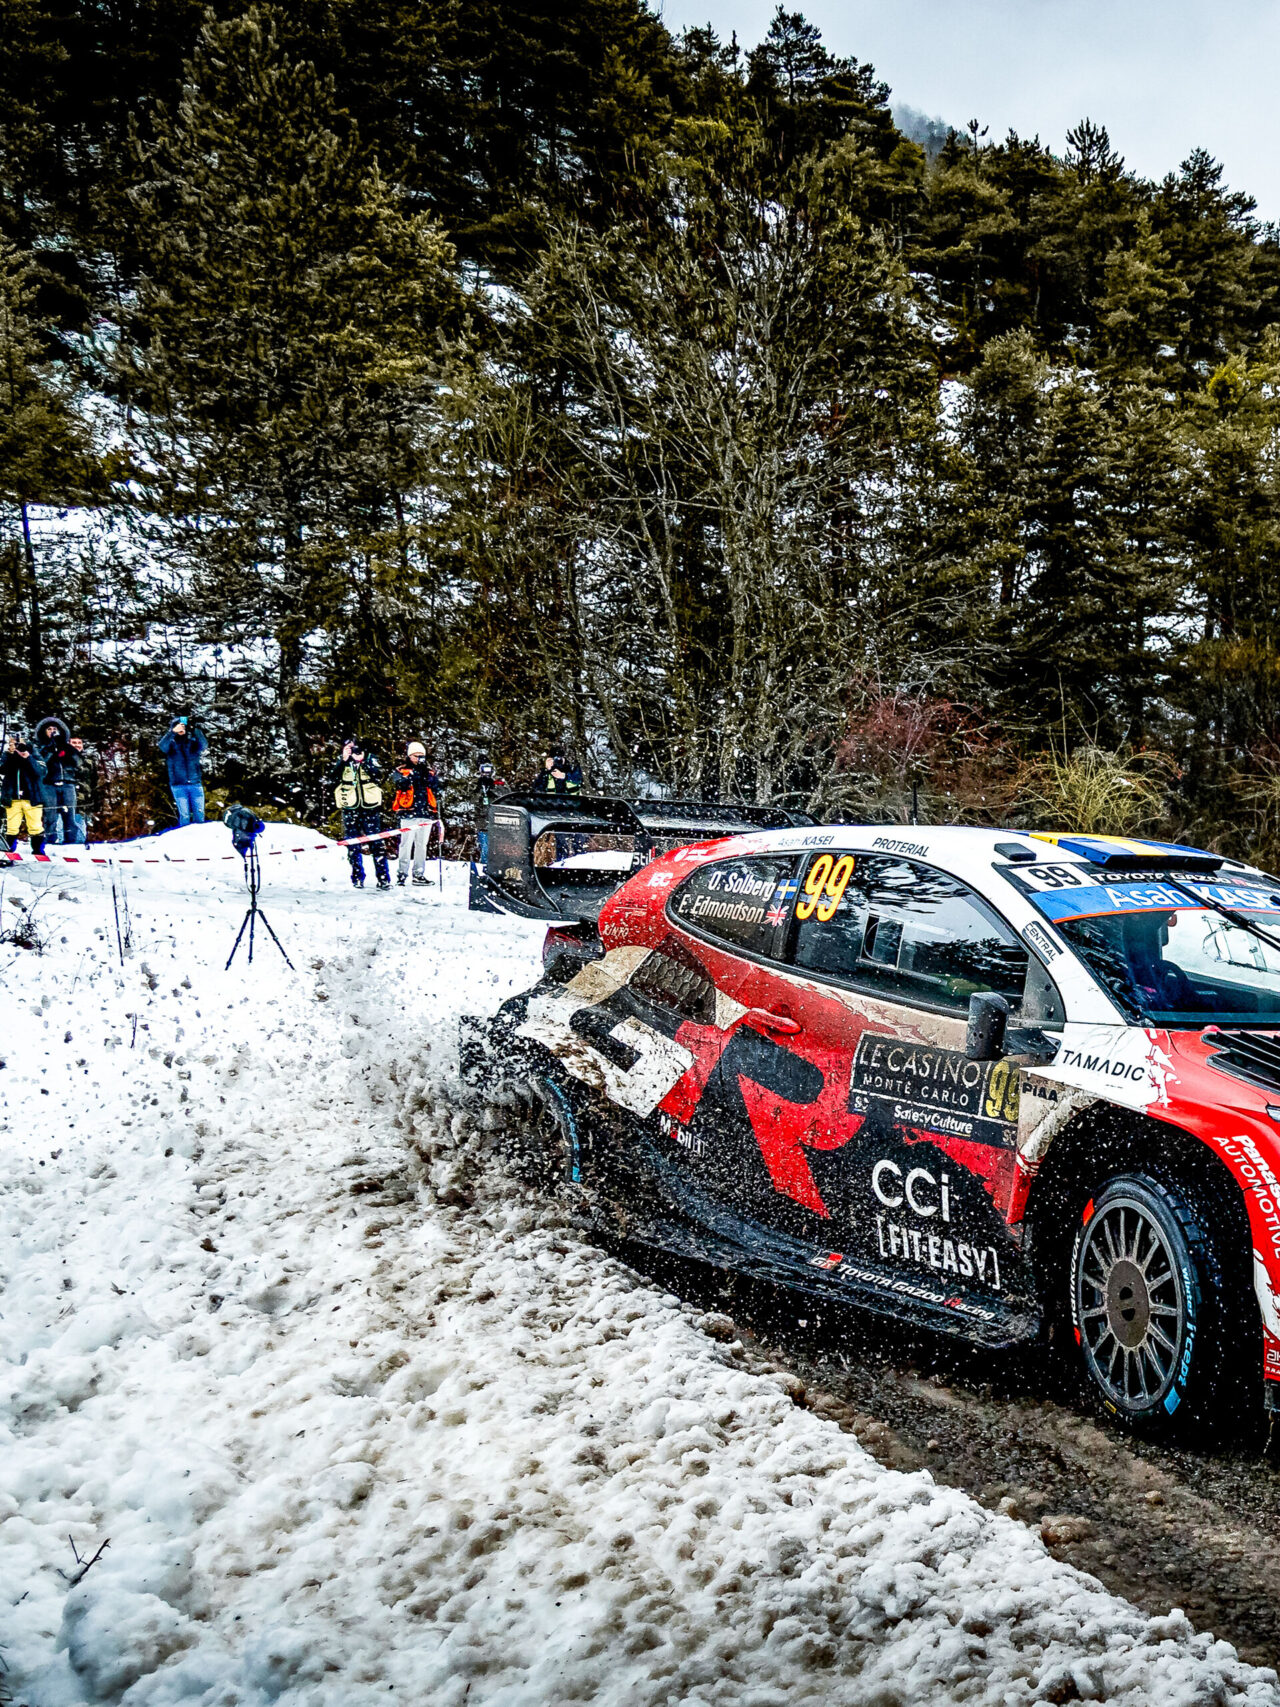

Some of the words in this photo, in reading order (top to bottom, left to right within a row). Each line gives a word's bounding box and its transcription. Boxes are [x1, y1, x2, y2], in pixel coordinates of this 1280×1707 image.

[801, 836, 835, 846] KASEI
[872, 837, 930, 858] PROTERIAL
[724, 872, 777, 901] Solberg
[795, 854, 855, 922] 99
[1028, 866, 1083, 888] 99
[690, 895, 765, 924] Edmondson
[1104, 884, 1196, 908] Asah
[1025, 922, 1056, 961] CENTRAL
[859, 1041, 886, 1068] LE
[887, 1047, 981, 1088] CASINO
[1062, 1050, 1145, 1081] TAMADIC
[862, 1073, 912, 1095] MONTE
[921, 1085, 969, 1107] CARLO
[985, 1060, 1019, 1121] 99
[1022, 1081, 1058, 1102] PIAA
[838, 1263, 893, 1287] TOYOTA
[891, 1280, 946, 1303] GAZOO
[943, 1297, 996, 1321] Racing
